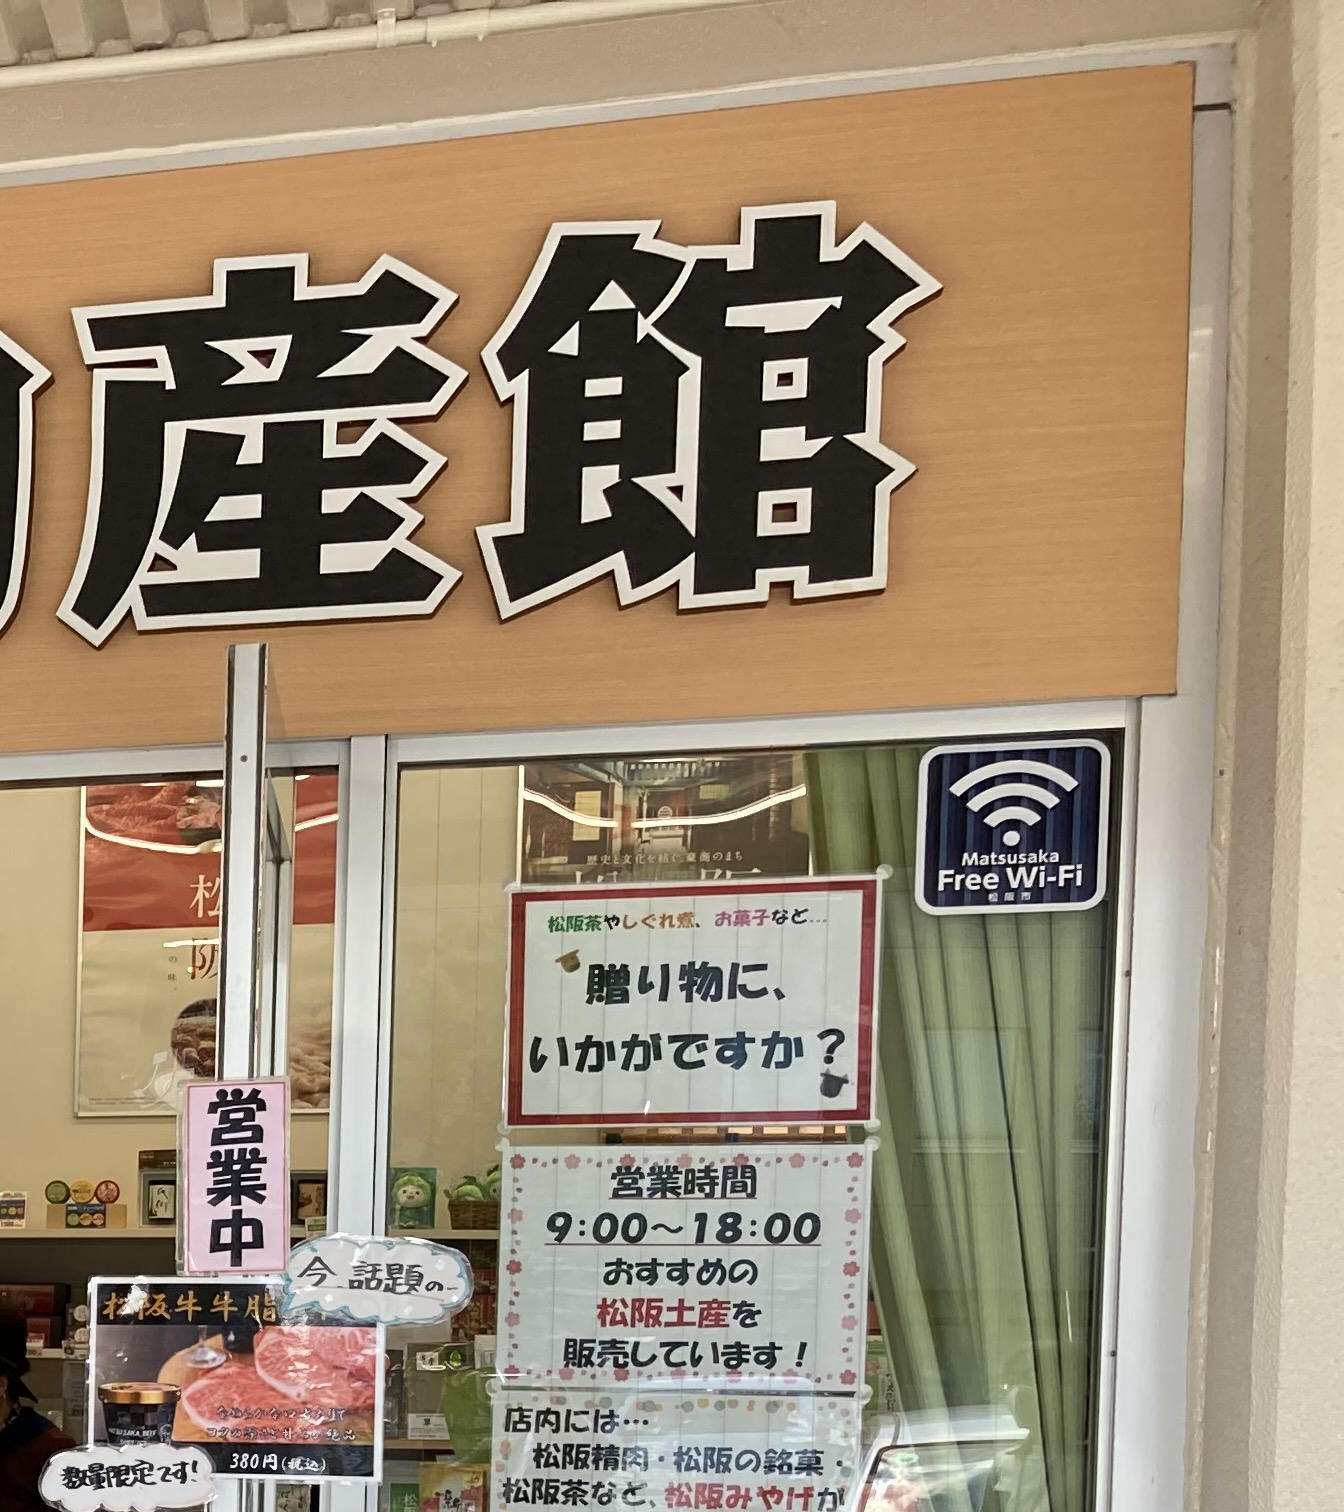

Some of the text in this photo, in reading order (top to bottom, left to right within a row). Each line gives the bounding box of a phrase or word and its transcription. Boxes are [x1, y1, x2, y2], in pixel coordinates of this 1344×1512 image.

[961, 849, 1060, 867] Matsusaka
[938, 866, 1084, 892] Free Wi-Fi
[585, 960, 788, 1006] 贈り物に、
[529, 1027, 846, 1074] いかがですか？
[206, 1087, 268, 1268] 営業中
[611, 1164, 758, 1199] 営業時間
[602, 1257, 759, 1287] おすすめの
[596, 1297, 763, 1330] 松阪土産を
[562, 1337, 810, 1370] 販売しています！
[501, 1477, 845, 1512] 松阪茶など、松阪みやげが
